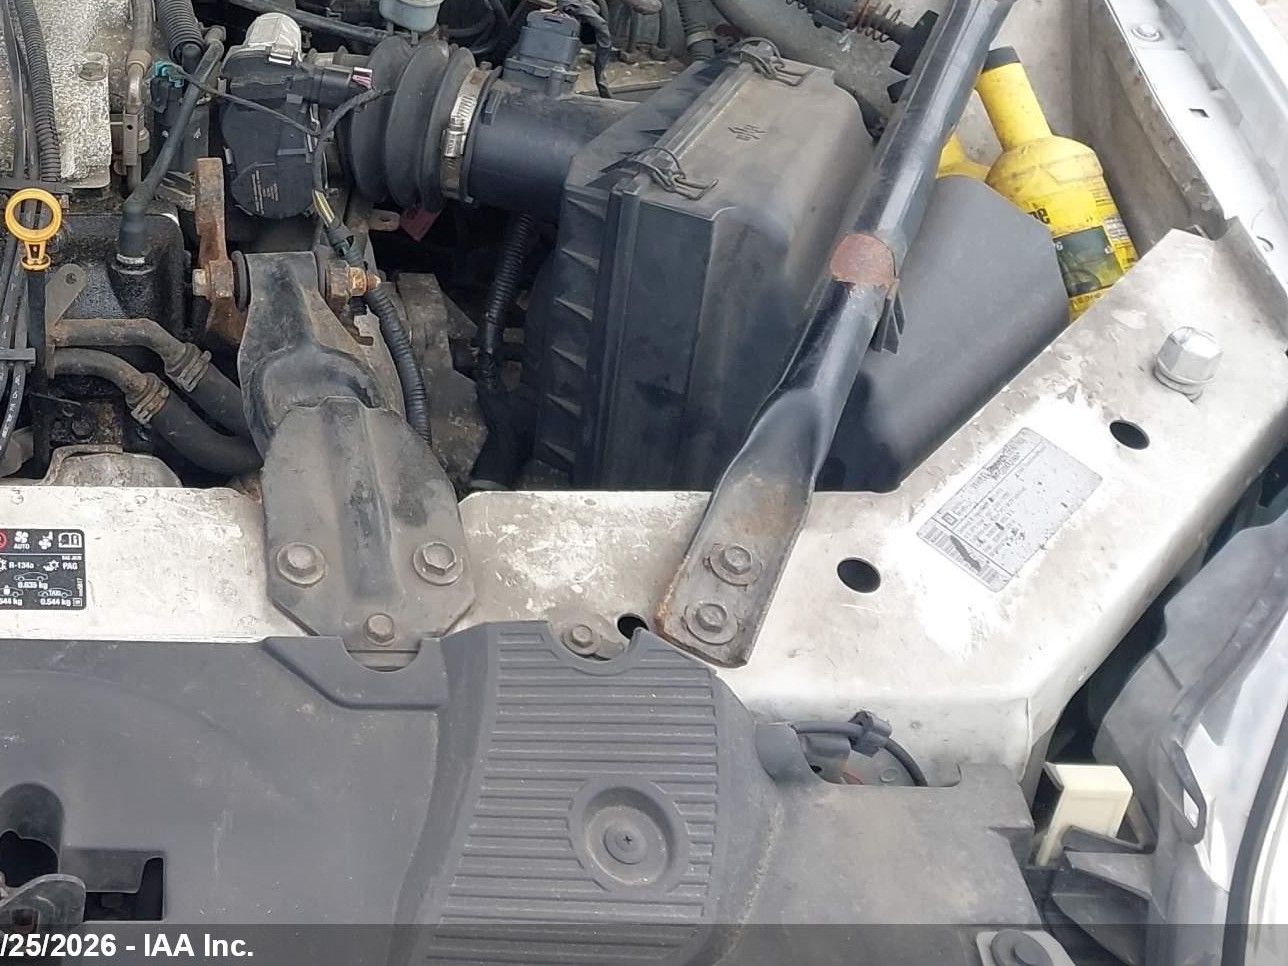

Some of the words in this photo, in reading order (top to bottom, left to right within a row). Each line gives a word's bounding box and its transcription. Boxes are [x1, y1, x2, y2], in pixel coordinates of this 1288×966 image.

[8, 561, 35, 569] R-134a
[62, 562, 78, 570] PAG
[39, 581, 49, 590] kg
[48, 589, 62, 597] TAXI
[12, 597, 23, 606] kg
[40, 597, 60, 605] 0.544
[61, 597, 71, 607] kg
